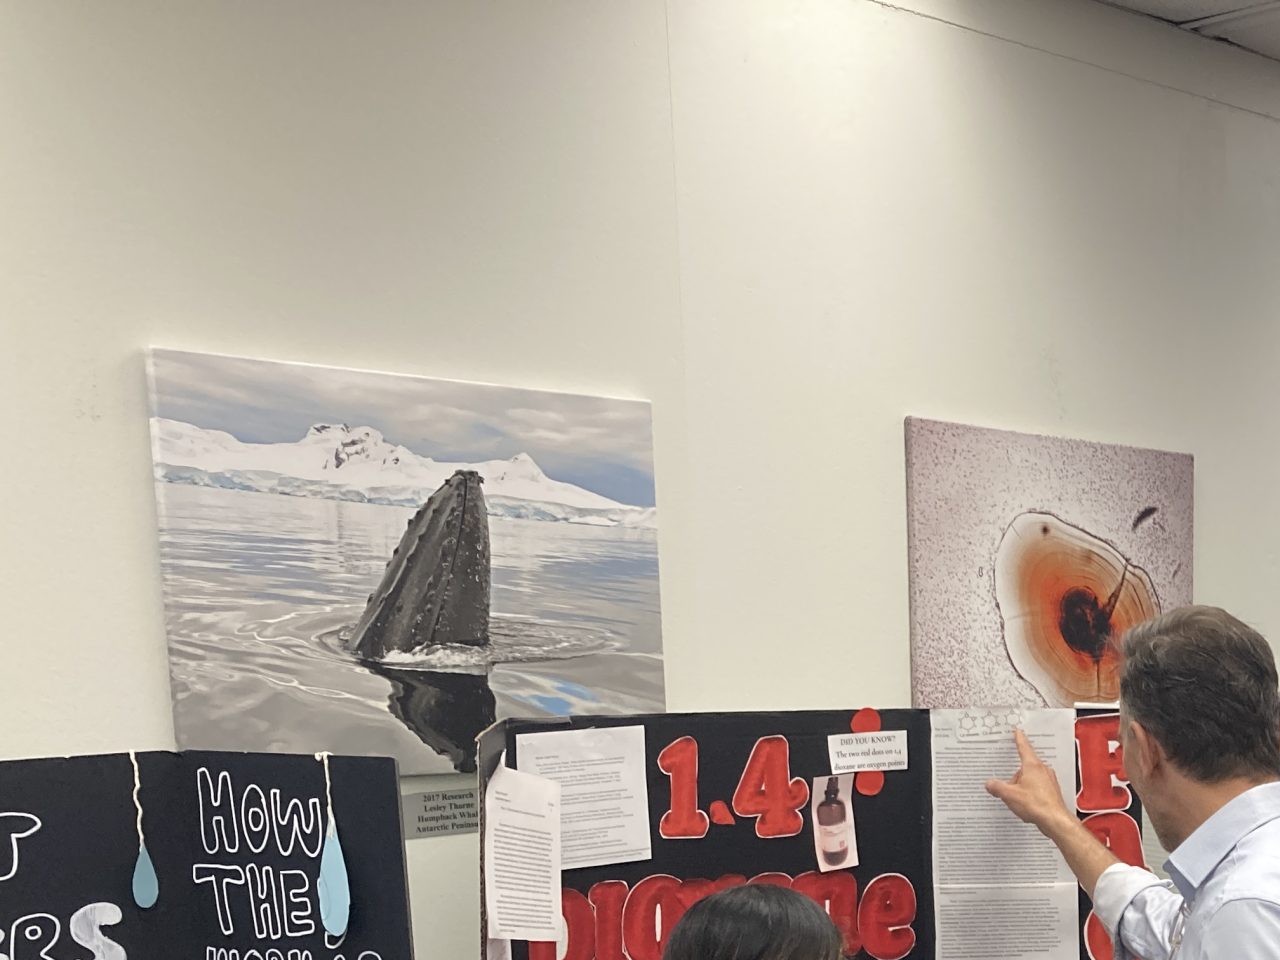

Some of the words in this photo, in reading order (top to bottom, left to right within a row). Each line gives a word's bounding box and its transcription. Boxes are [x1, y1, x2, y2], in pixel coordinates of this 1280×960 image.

[840, 738, 853, 746] DID
[855, 736, 870, 744] YOU
[871, 735, 896, 744] KNOW?
[836, 751, 847, 759] The
[861, 748, 870, 756] red
[834, 763, 855, 771] dioxane
[867, 761, 887, 769] oxygen
[423, 793, 439, 802] 2017
[442, 792, 474, 800] Research
[197, 767, 323, 858] HOW
[418, 813, 457, 823] Humpback
[416, 824, 449, 833] Antarctic
